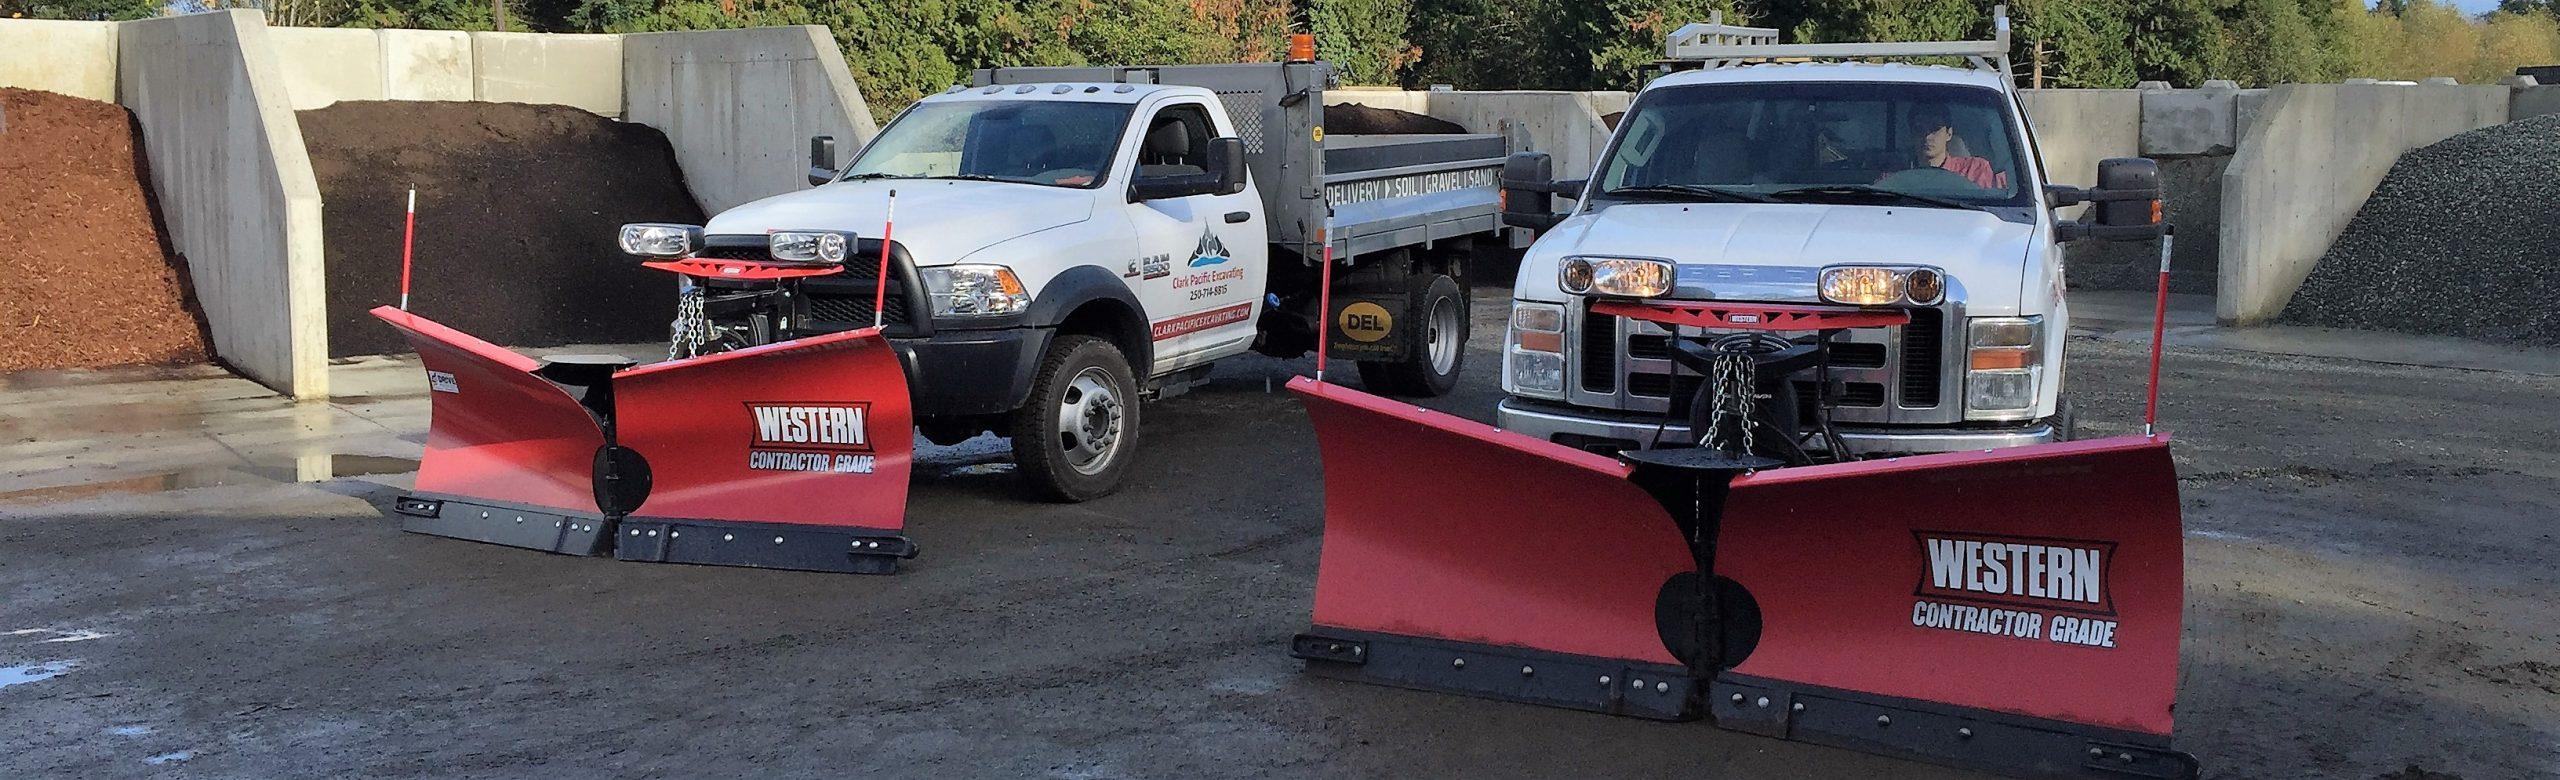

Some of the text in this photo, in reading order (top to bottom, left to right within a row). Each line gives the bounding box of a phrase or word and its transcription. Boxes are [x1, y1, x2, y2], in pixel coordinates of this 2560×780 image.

[1326, 168, 1493, 207] DELIVERY SOIL GRAVEL SAND
[1143, 253, 1170, 265] RAM
[1172, 276, 1189, 290] Clark
[1190, 272, 1211, 286] Pacific
[1212, 266, 1244, 282] Excavating
[1153, 306, 1250, 338] CLARKPACIFICEXCAVATING.COM
[1347, 313, 1384, 332] DEL
[754, 406, 864, 445] WESTERN
[749, 451, 875, 474] CONTRACTOR GRADE
[1927, 538, 2100, 603] WESTERN
[1912, 600, 2118, 648] CONTRACTOR GRADE
